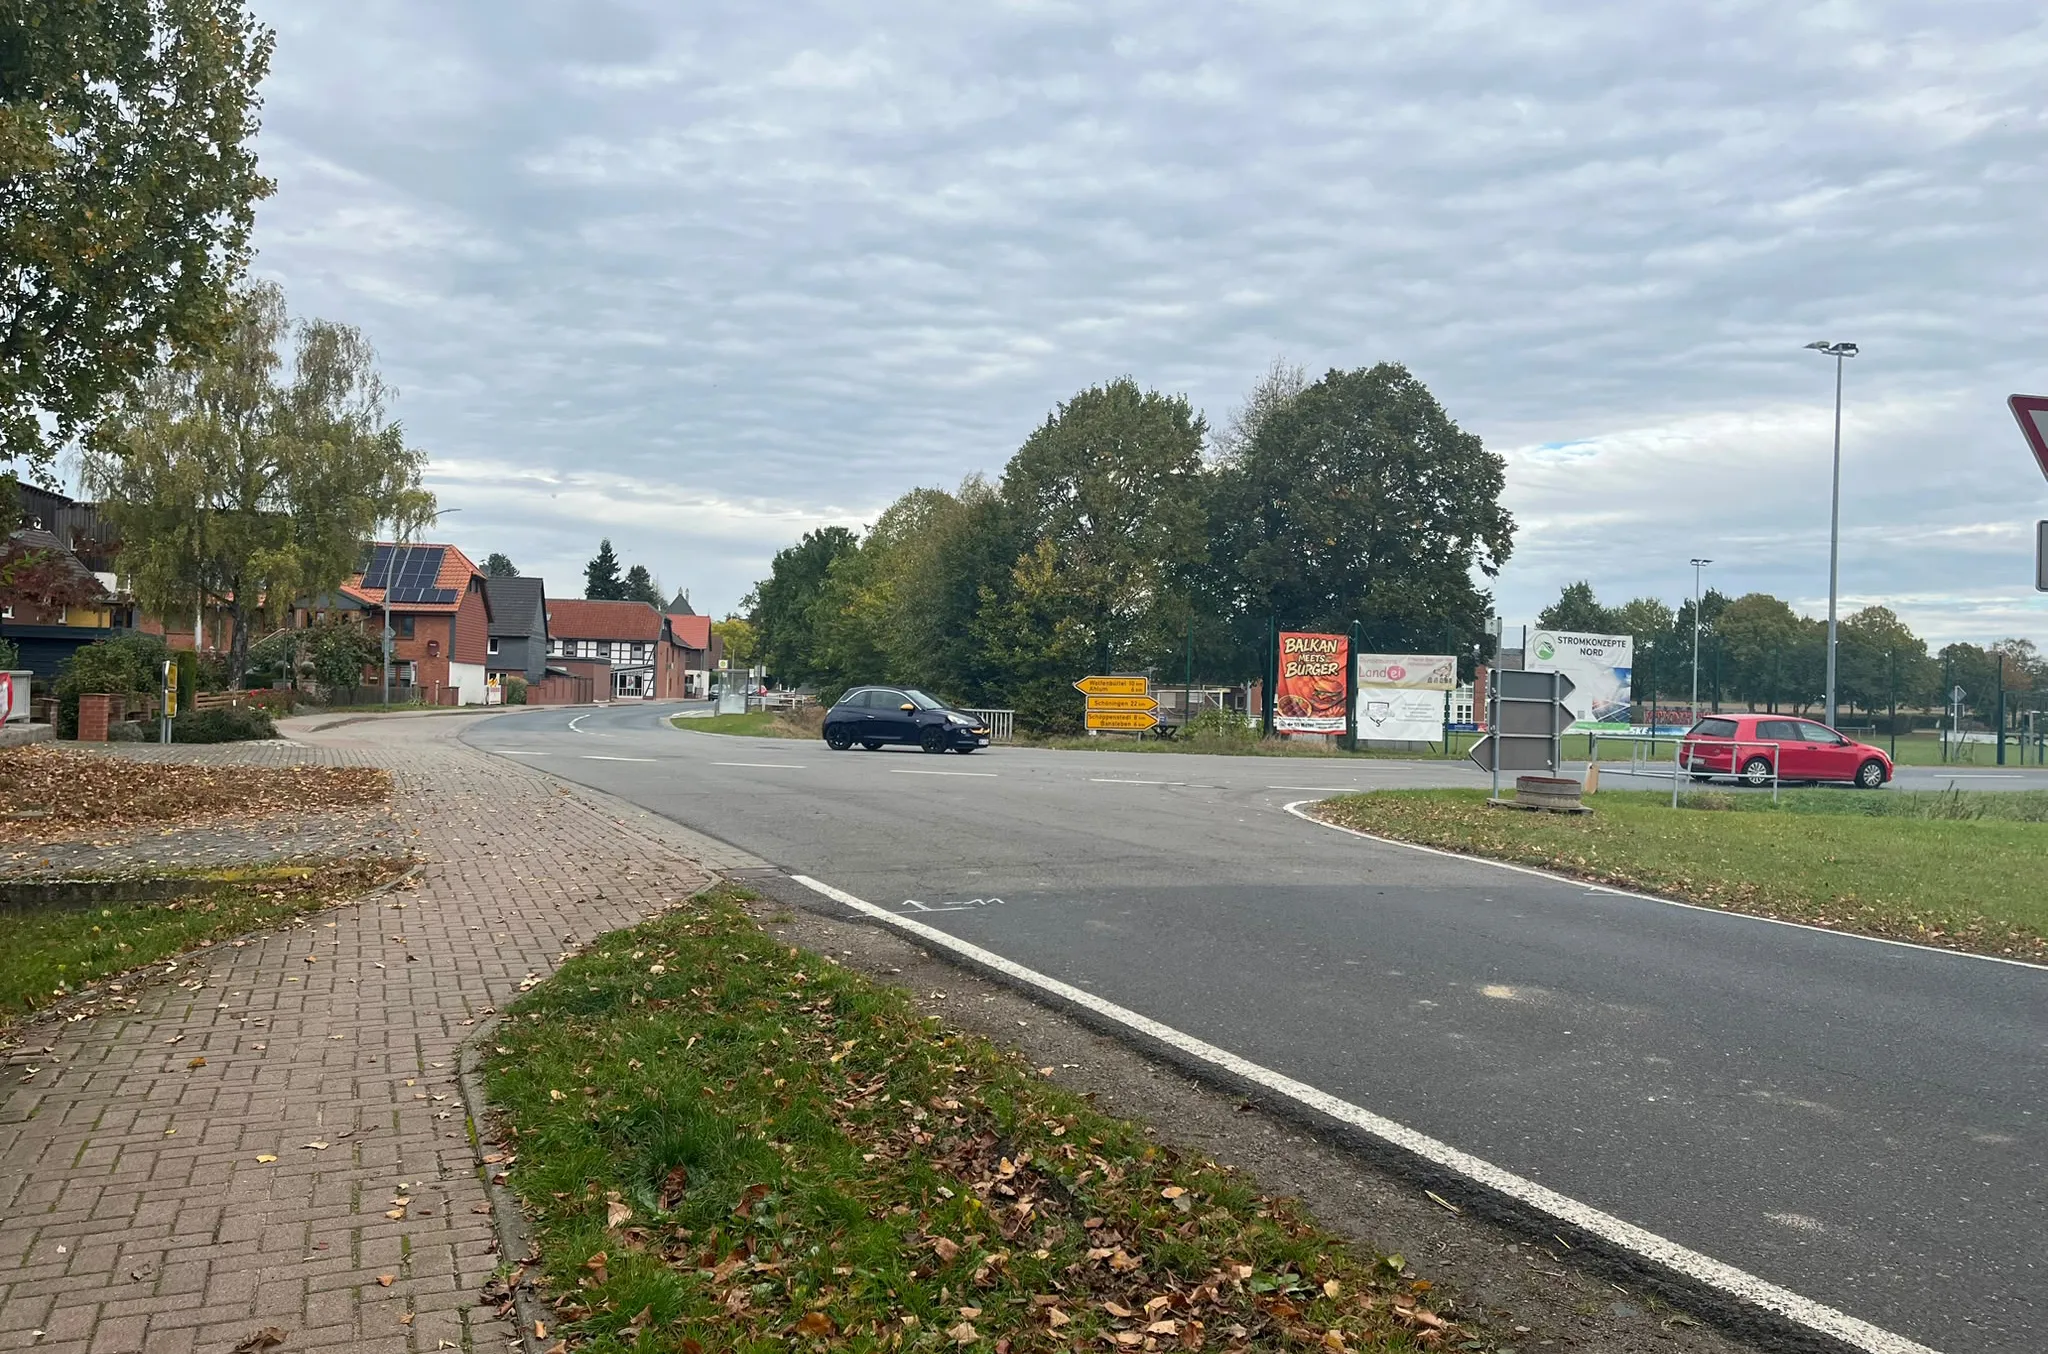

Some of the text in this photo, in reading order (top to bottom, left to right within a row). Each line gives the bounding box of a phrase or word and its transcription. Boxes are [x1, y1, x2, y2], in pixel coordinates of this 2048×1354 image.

[1284, 637, 1338, 654] BALKAN
[1557, 636, 1626, 648] STROMKONZEPTE
[1298, 654, 1326, 663] MEETS
[1580, 648, 1604, 657] NORD
[1284, 662, 1339, 678] BURGER
